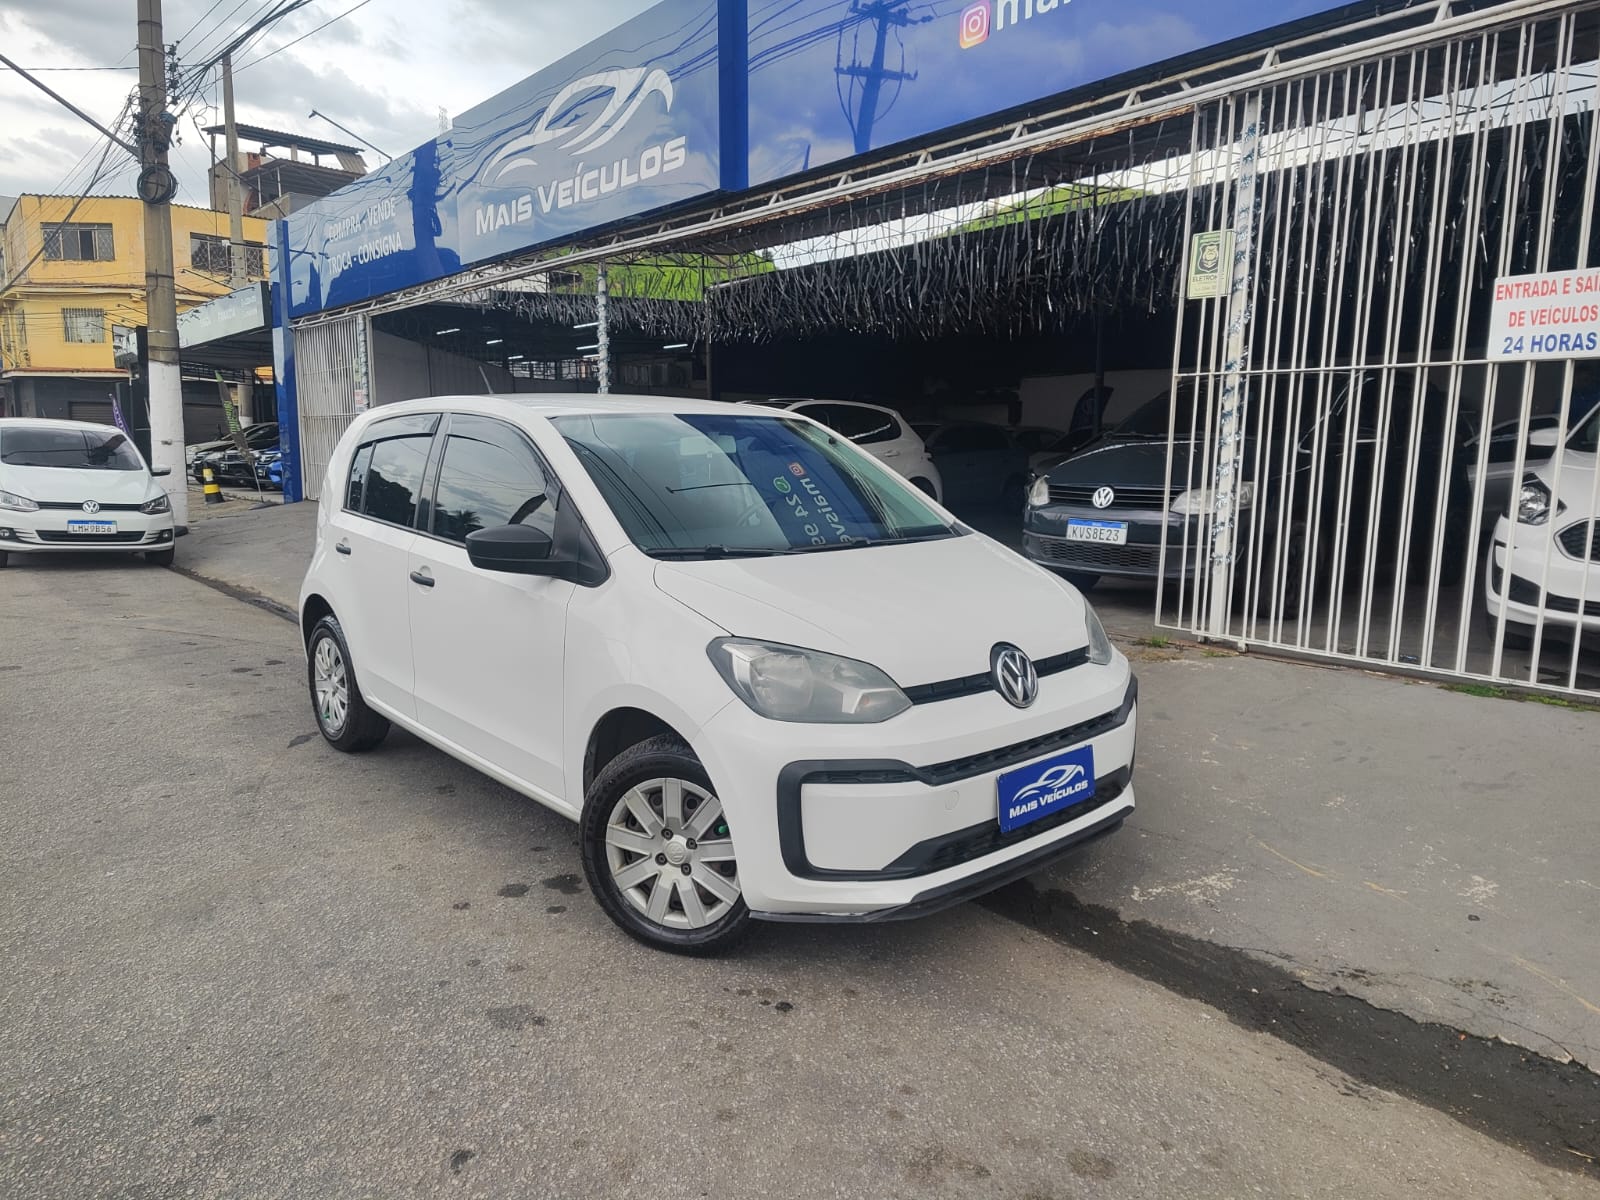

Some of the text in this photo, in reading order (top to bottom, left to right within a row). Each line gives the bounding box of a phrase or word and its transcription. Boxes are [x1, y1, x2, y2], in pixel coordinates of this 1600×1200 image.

[475, 136, 686, 236] MAIS VEÍCULOS
[328, 197, 396, 242] COMPRA VENDE
[327, 231, 403, 275] TROCA CONSIGNA
[1496, 272, 1600, 301] ENTRADA E SAÍ
[1508, 304, 1599, 328] DE VEÍCULOS
[1502, 332, 1598, 355] 24 HORAS
[1072, 526, 1120, 541] KVS8E23
[1009, 780, 1089, 819] MAIS VEÍCULOS
